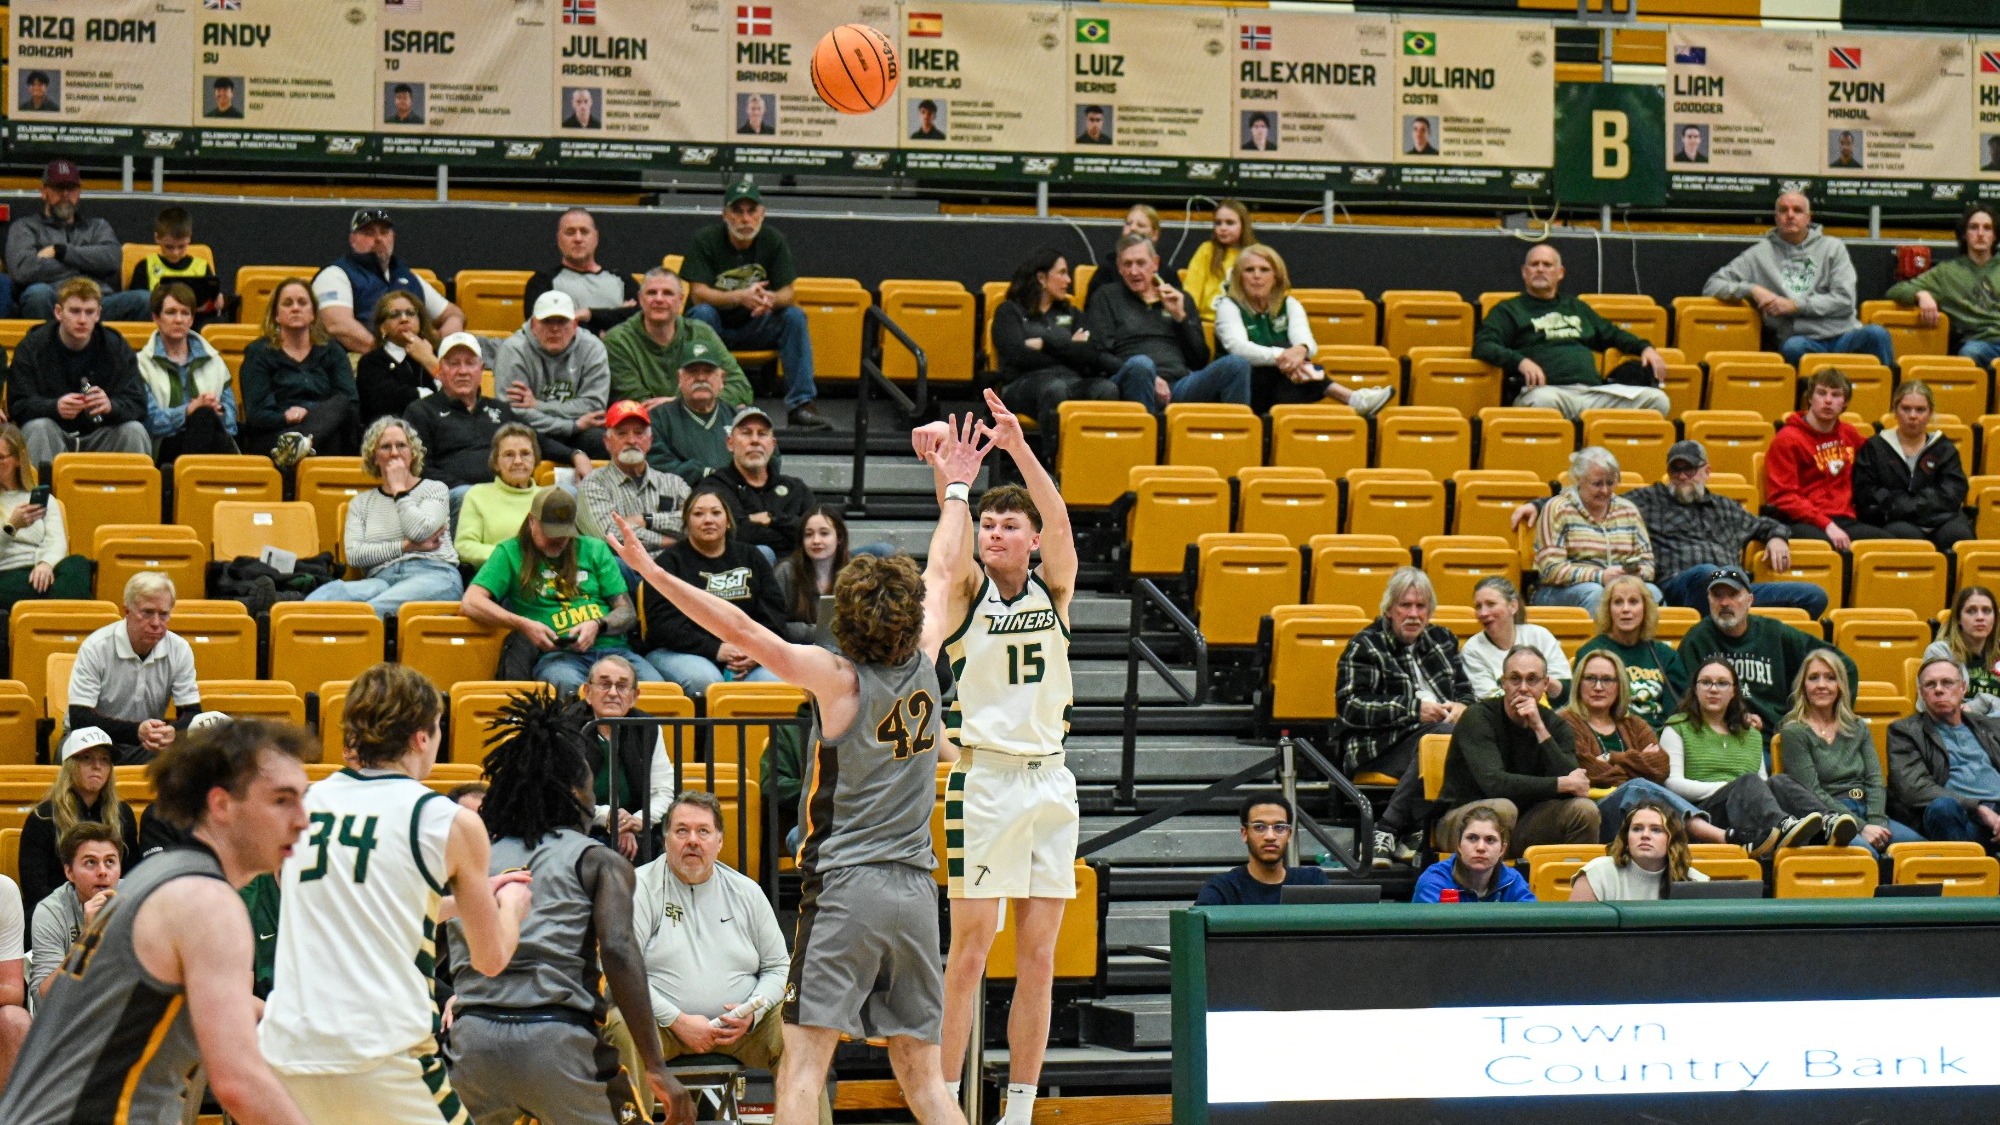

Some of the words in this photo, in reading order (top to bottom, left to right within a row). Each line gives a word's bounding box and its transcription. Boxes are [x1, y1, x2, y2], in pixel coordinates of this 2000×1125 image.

[18, 15, 74, 40] RIZQ
[86, 18, 156, 43] ADAM
[203, 23, 271, 47] ANDY
[18, 45, 73, 58] ROHIZAM
[384, 29, 455, 54] ISAAC
[562, 36, 647, 60] JULIAN
[737, 42, 791, 66] MIKE
[908, 48, 959, 71] IKER
[1075, 54, 1124, 76] LUIZ
[908, 76, 961, 89] BERMEJO
[1241, 61, 1376, 86] ALEXANDER
[1402, 66, 1495, 90] JULIANO
[1674, 75, 1724, 97] LIAM
[1828, 81, 1884, 103] ZYON
[1402, 94, 1438, 105] COSTA
[1592, 110, 1630, 179] B
[705, 568, 751, 590] S&T
[552, 603, 604, 629] UMR
[989, 612, 1055, 632] MINERS
[1007, 643, 1046, 685] 15
[1729, 658, 1773, 685] OURI
[876, 689, 936, 760] 42
[299, 811, 379, 884] 34
[1482, 1016, 1667, 1044] Town
[1484, 1055, 1770, 1091] Country
[1804, 1046, 1968, 1078] Bank
